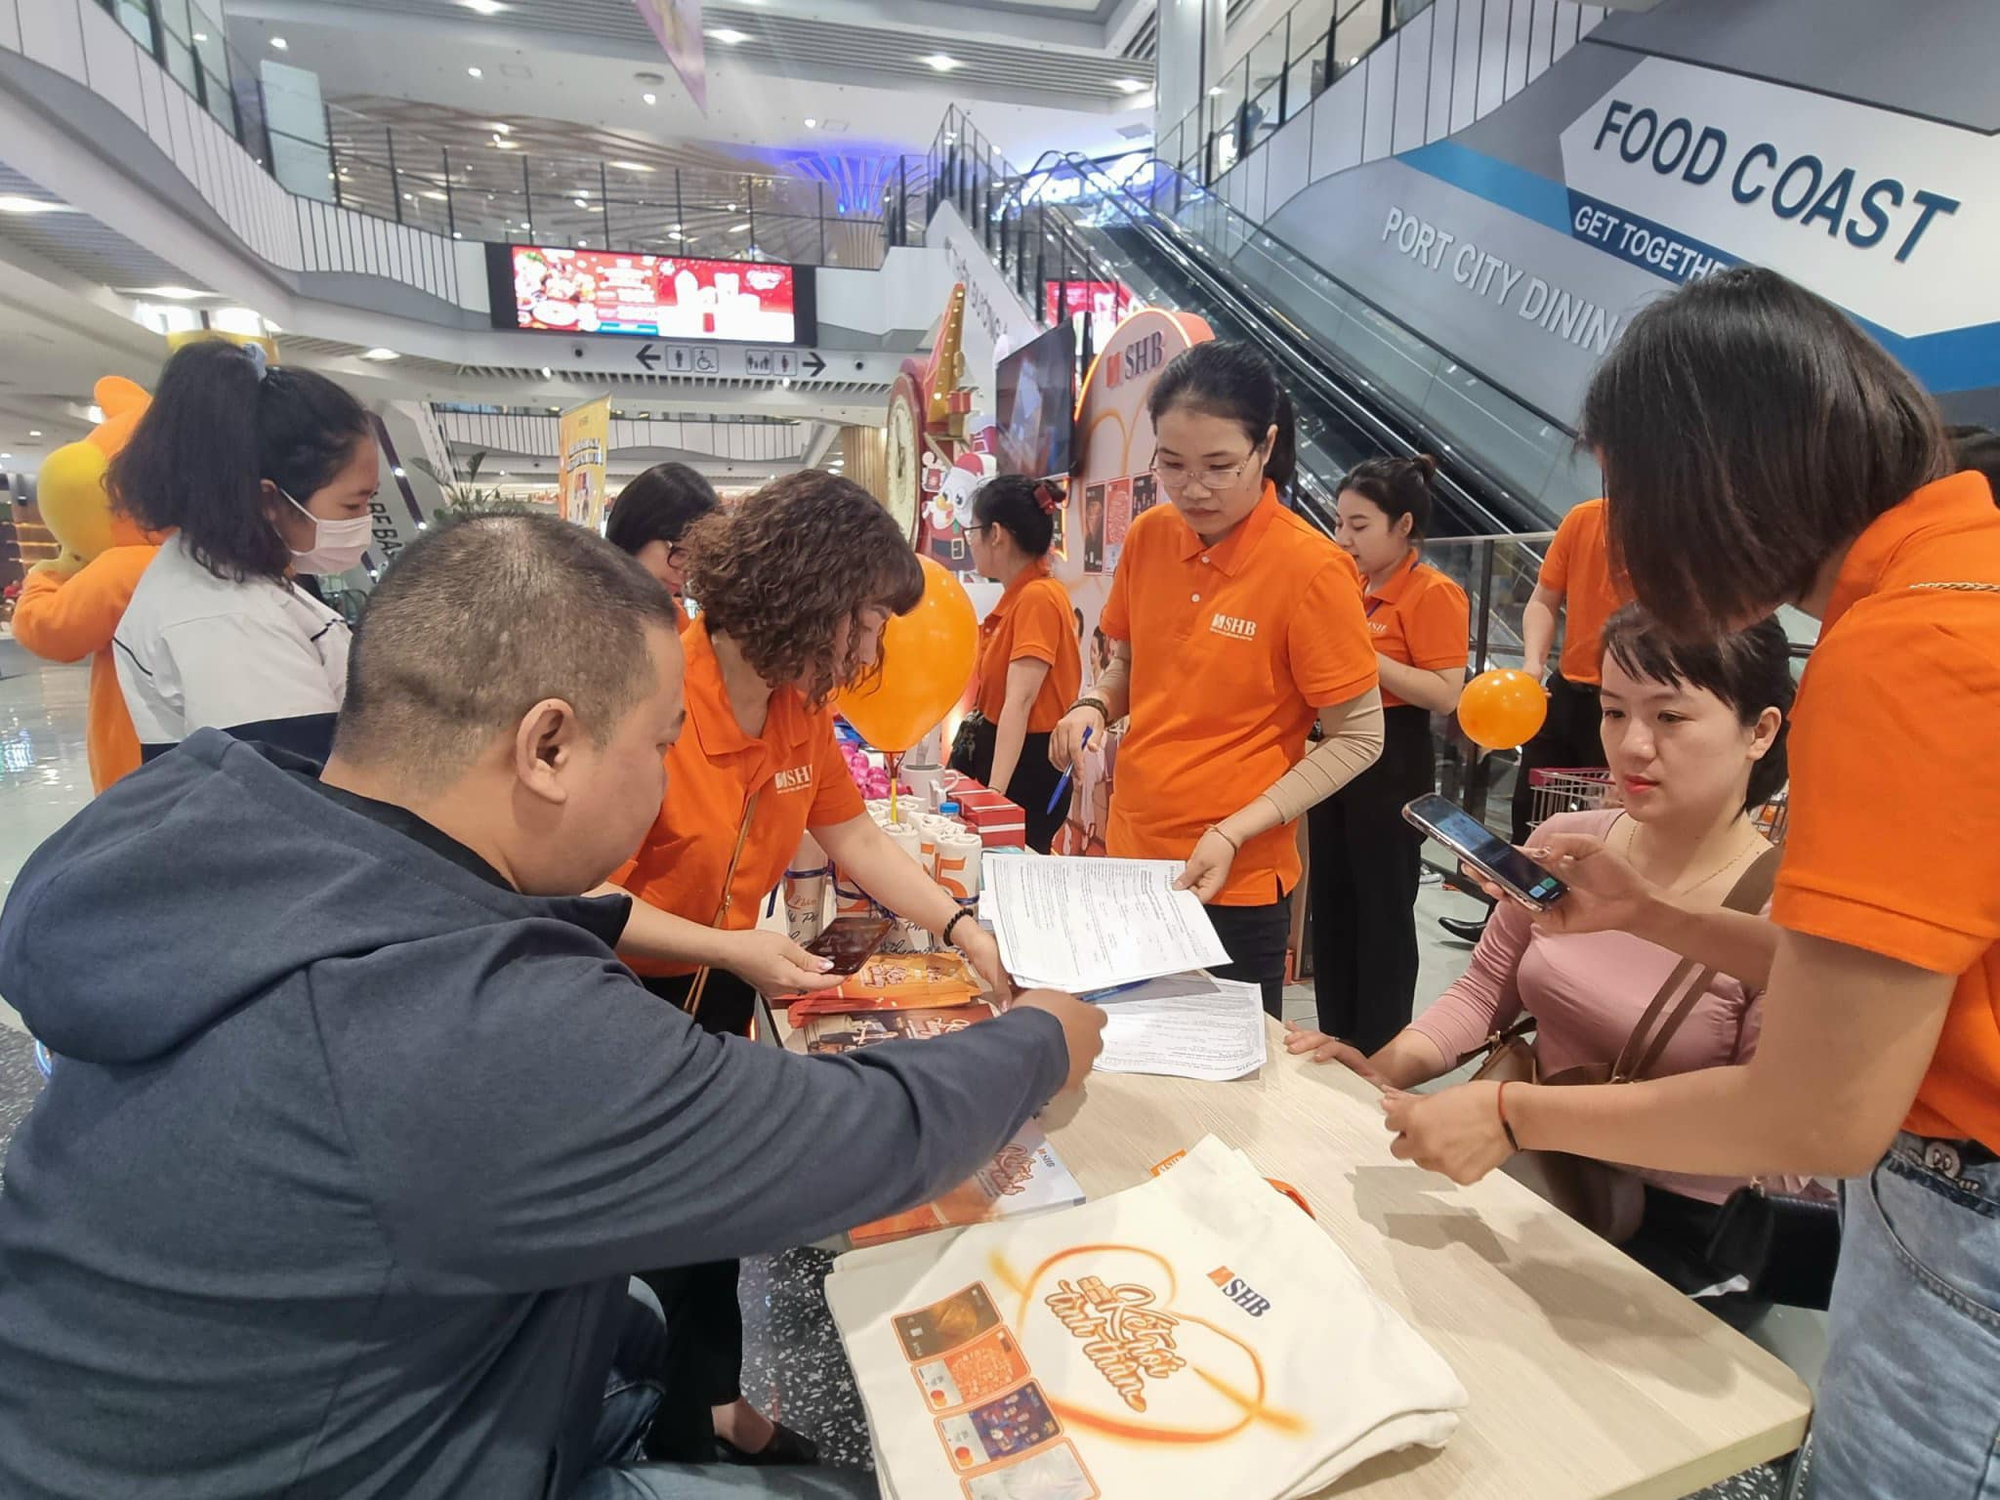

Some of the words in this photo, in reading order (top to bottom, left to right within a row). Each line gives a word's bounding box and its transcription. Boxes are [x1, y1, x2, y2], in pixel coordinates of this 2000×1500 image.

[1593, 100, 1727, 185] FOOD
[1731, 143, 1961, 265] COAST
[1574, 206, 1619, 242] GET
[1382, 207, 1454, 270] PORT
[1453, 243, 1526, 306] CITY
[1519, 277, 1623, 356] DININ
[1125, 331, 1163, 380] SHB
[1223, 616, 1257, 636] SHB
[1222, 1278, 1271, 1317] SHB
